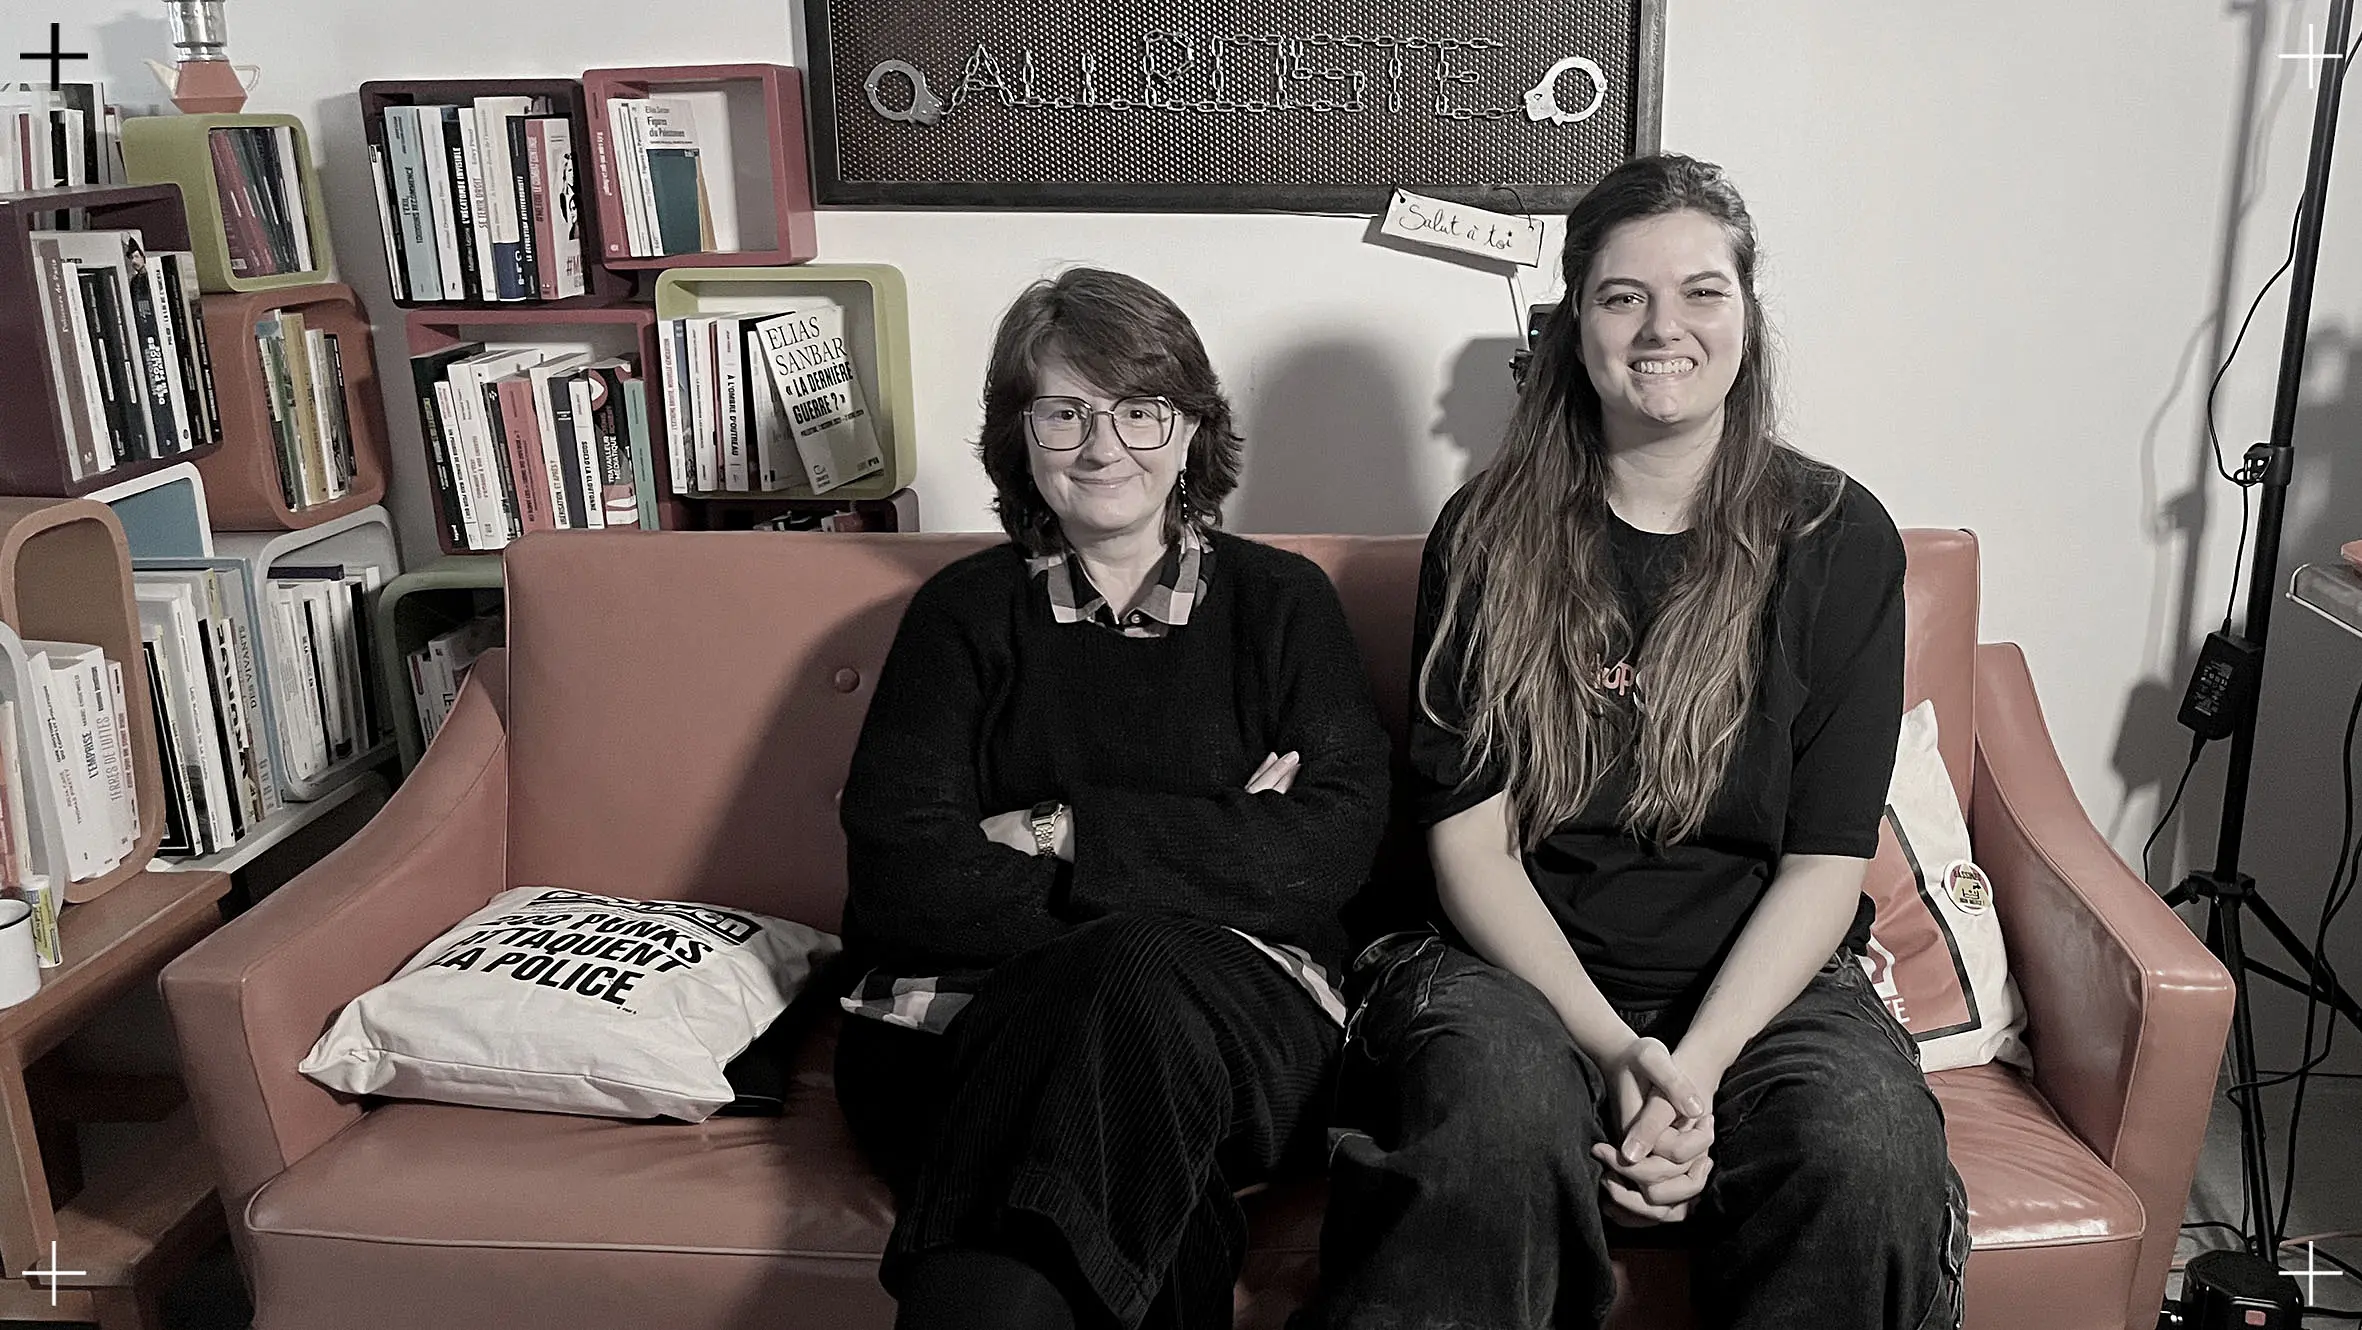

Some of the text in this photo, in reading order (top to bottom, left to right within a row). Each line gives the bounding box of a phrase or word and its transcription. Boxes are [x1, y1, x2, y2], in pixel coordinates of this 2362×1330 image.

[453, 147, 464, 179] INVISIBLE
[472, 178, 483, 198] DROIT
[476, 199, 487, 218] TENIR
[478, 220, 488, 228] SE
[1399, 204, 1513, 249] Salut à toi
[767, 316, 820, 350] ELIAS
[775, 337, 848, 376] SANBAR
[792, 377, 806, 397] LA
[809, 361, 854, 392] DERNIÈRE
[727, 382, 736, 413] L'OMBRE
[792, 395, 832, 425] GUERRE
[730, 416, 738, 456] D'OUTREAU
[584, 466, 591, 474] LA
[603, 436, 614, 482] TRAVAILLEUR
[610, 435, 620, 479] MÉDIATIQUE
[237, 626, 257, 708] DES VIVANTS
[96, 717, 113, 750] LUTTES
[82, 731, 98, 778] L'EMPRISE
[102, 752, 116, 764] DE
[106, 766, 122, 800] TERRES
[447, 927, 693, 973] ATTAQUENT
[566, 913, 715, 964] PUNKS
[424, 948, 645, 1005] LA POLICE
